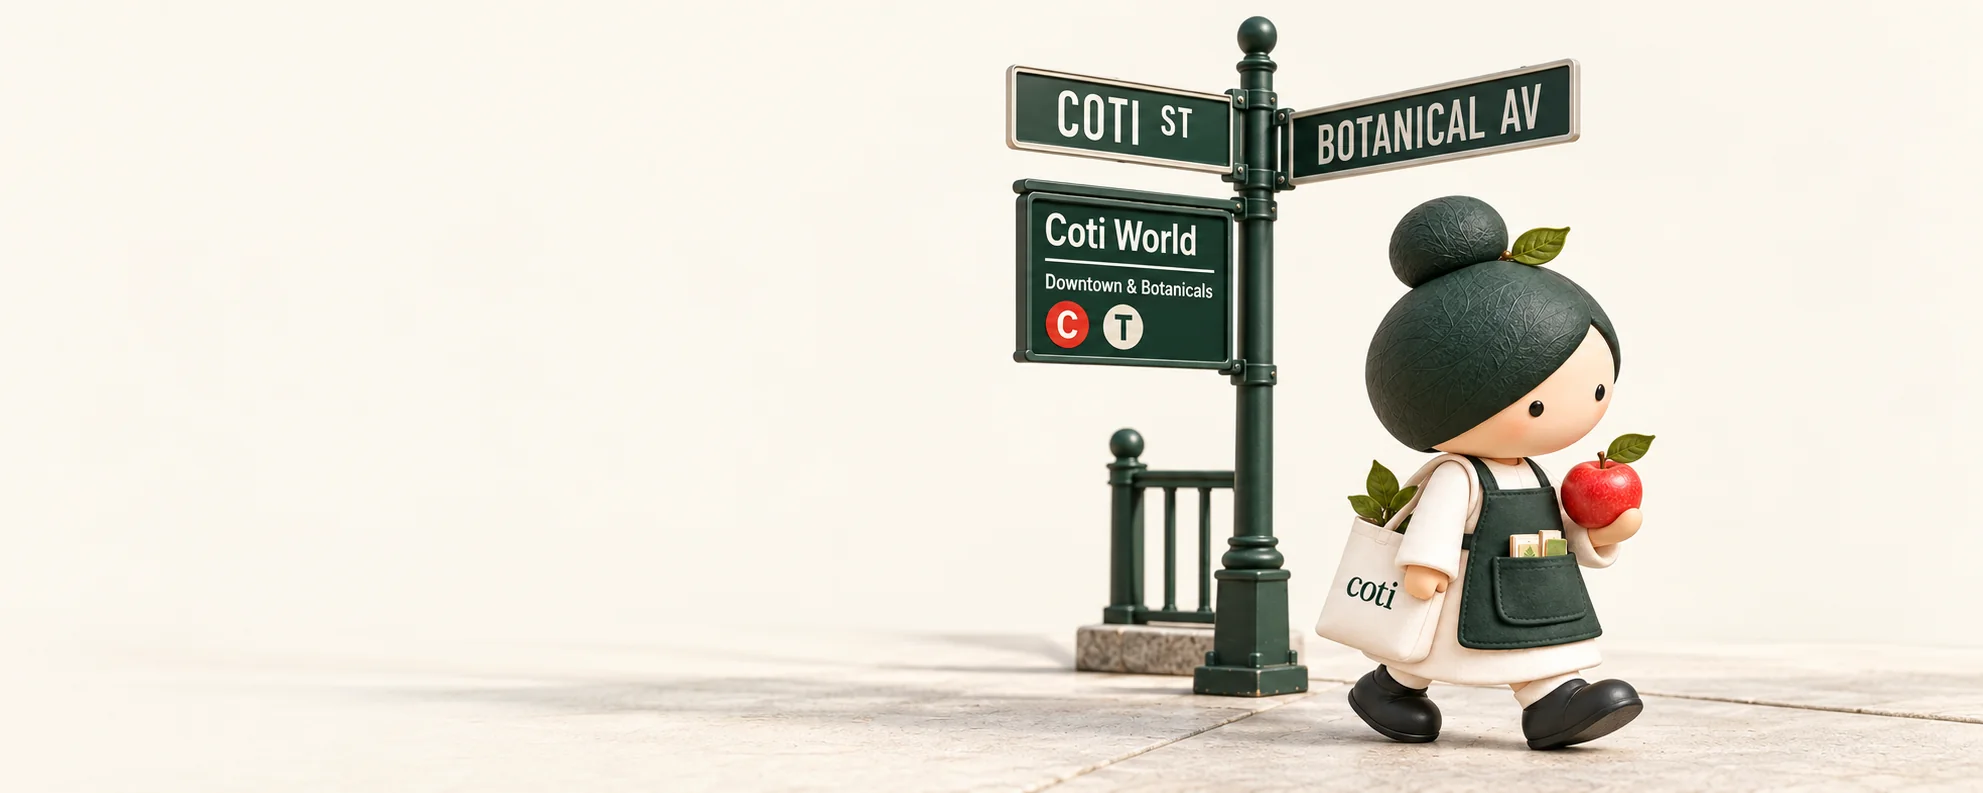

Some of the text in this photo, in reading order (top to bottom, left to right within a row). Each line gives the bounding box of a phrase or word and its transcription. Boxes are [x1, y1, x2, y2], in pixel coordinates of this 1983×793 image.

[1058, 90, 1193, 146] COTI ST
[1318, 83, 1542, 166] BOTANICAL AV
[1045, 212, 1197, 256] Coti World
[1045, 273, 1213, 299] Downtown & Botanicals
[1057, 309, 1133, 341] C T
[1346, 576, 1399, 610] coti
